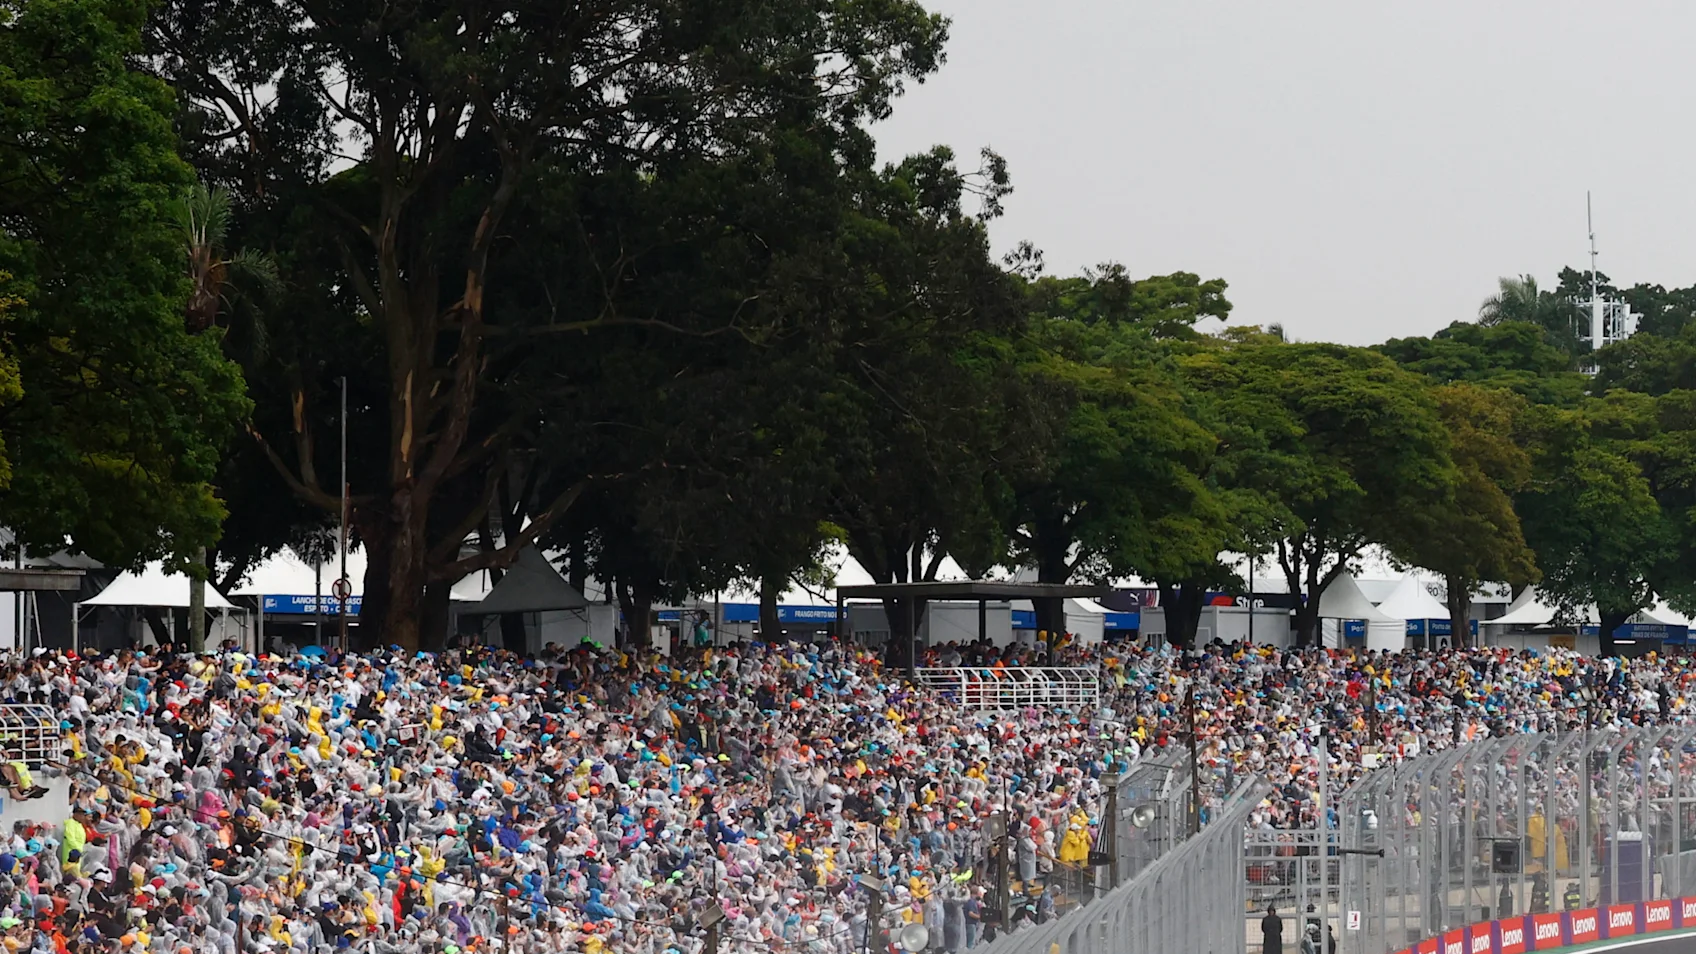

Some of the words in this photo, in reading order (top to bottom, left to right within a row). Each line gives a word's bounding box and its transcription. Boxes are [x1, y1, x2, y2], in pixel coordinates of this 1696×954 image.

[1236, 596, 1264, 608] Stre
[1609, 910, 1632, 928] Lenovo
[1646, 906, 1670, 923] Lenovo
[1535, 922, 1559, 940] Lenovo
[1573, 917, 1595, 935] Lenovo
[1472, 934, 1490, 954] Lenovo
[1501, 929, 1523, 947] Lenovo
